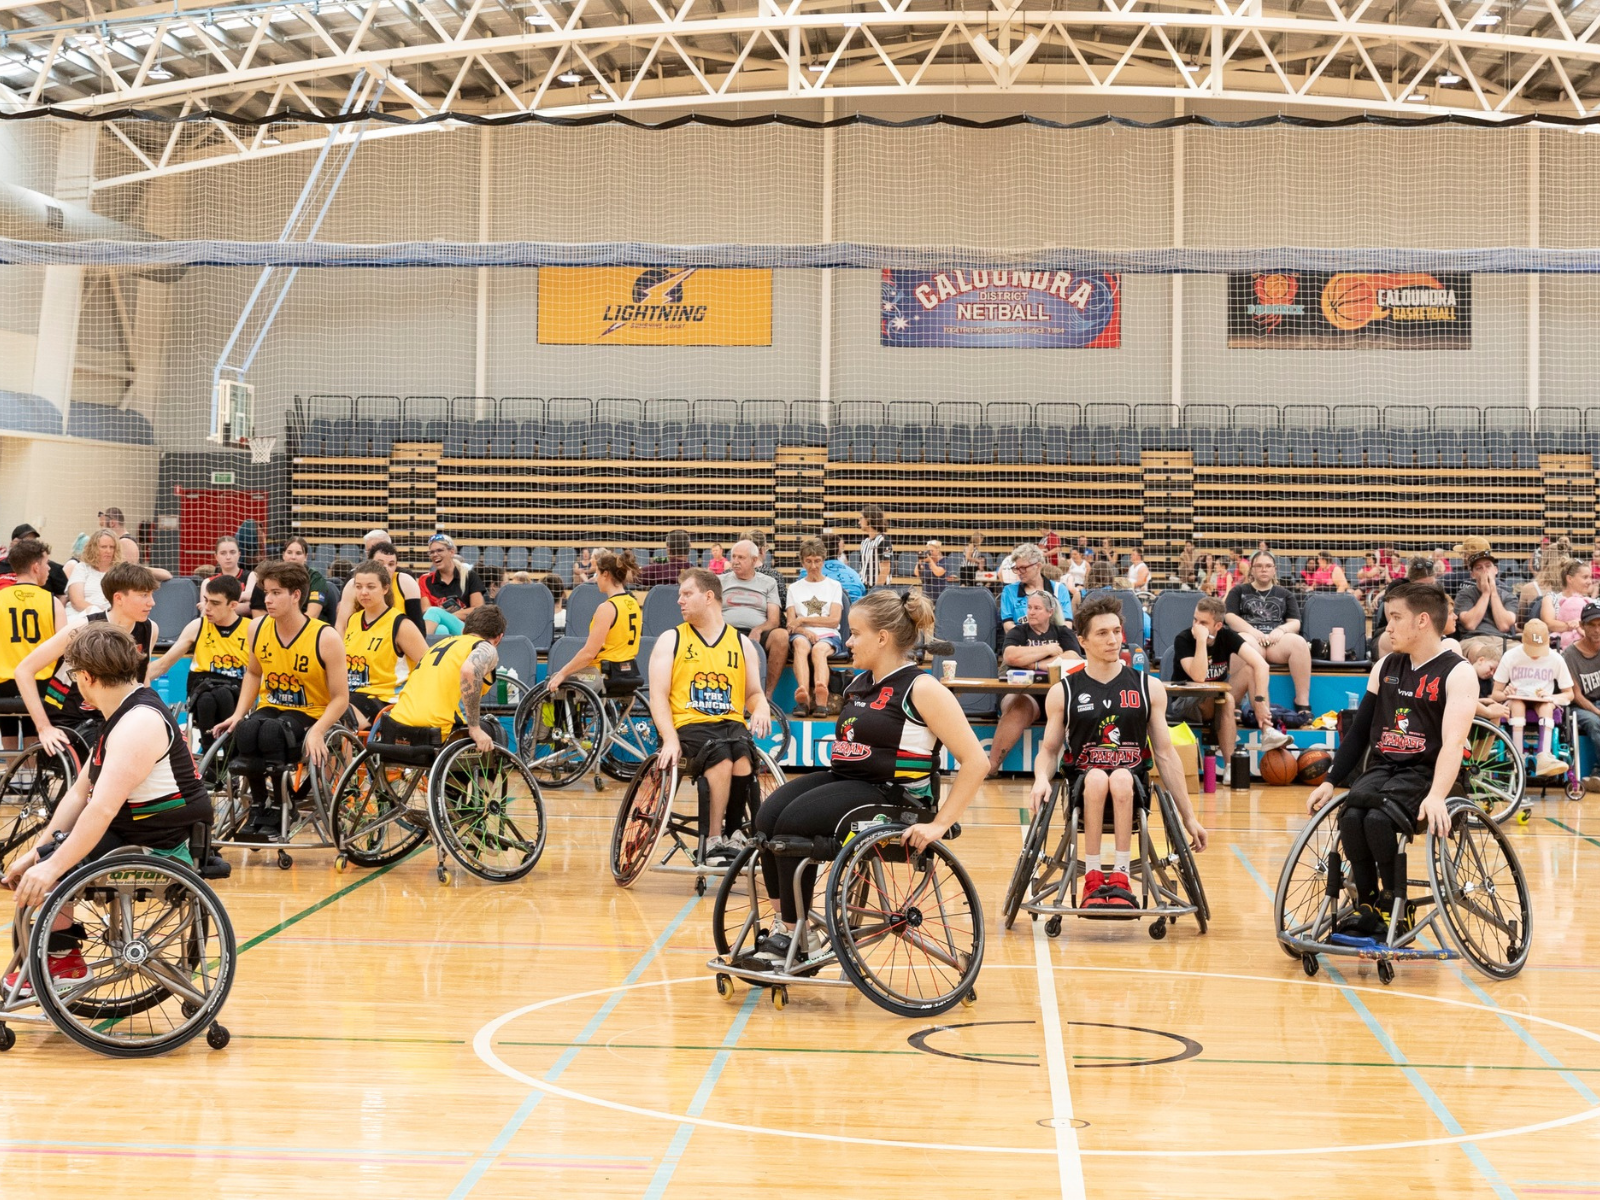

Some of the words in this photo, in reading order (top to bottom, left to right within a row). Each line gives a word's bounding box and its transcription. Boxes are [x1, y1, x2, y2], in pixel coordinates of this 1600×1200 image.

[979, 291, 1028, 301] DISTRICT
[1377, 289, 1457, 307] CALOUNDRA
[603, 305, 707, 321] LIGHTNING
[957, 303, 1050, 320] NETBALL
[1392, 307, 1457, 320] BASKETBALL
[8, 607, 41, 644] 10
[627, 613, 637, 646] 5
[238, 637, 246, 651] 7
[367, 637, 384, 652] 17
[1532, 633, 1543, 644] LA
[293, 653, 309, 673] 12
[727, 650, 738, 669] 11
[1511, 666, 1554, 681] CHICAGO
[1415, 674, 1440, 701] 14
[703, 692, 722, 701] THE
[1120, 689, 1140, 708] 10
